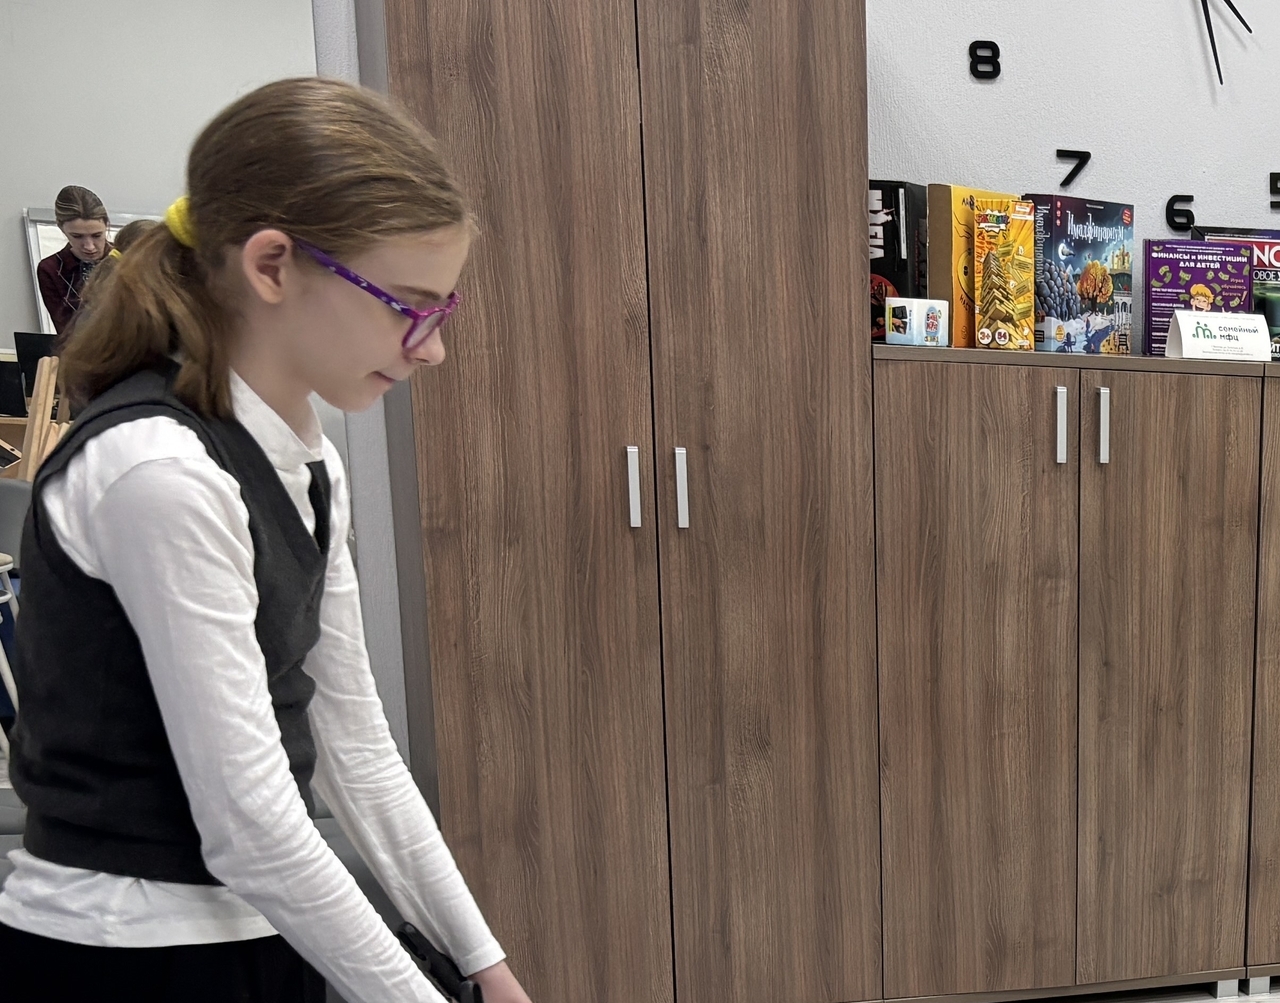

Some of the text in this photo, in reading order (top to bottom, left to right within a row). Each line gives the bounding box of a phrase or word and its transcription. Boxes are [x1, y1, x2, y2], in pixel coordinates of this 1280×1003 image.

[969, 41, 1000, 79] 8
[1056, 149, 1091, 187] 7
[1166, 195, 1195, 231] 6
[1151, 252, 1190, 260] ФИНАНСЫ
[1197, 254, 1248, 263] ИНВЕСТИЦИИ
[1253, 270, 1276, 280] ОВОЕ
[980, 331, 991, 341] 3+
